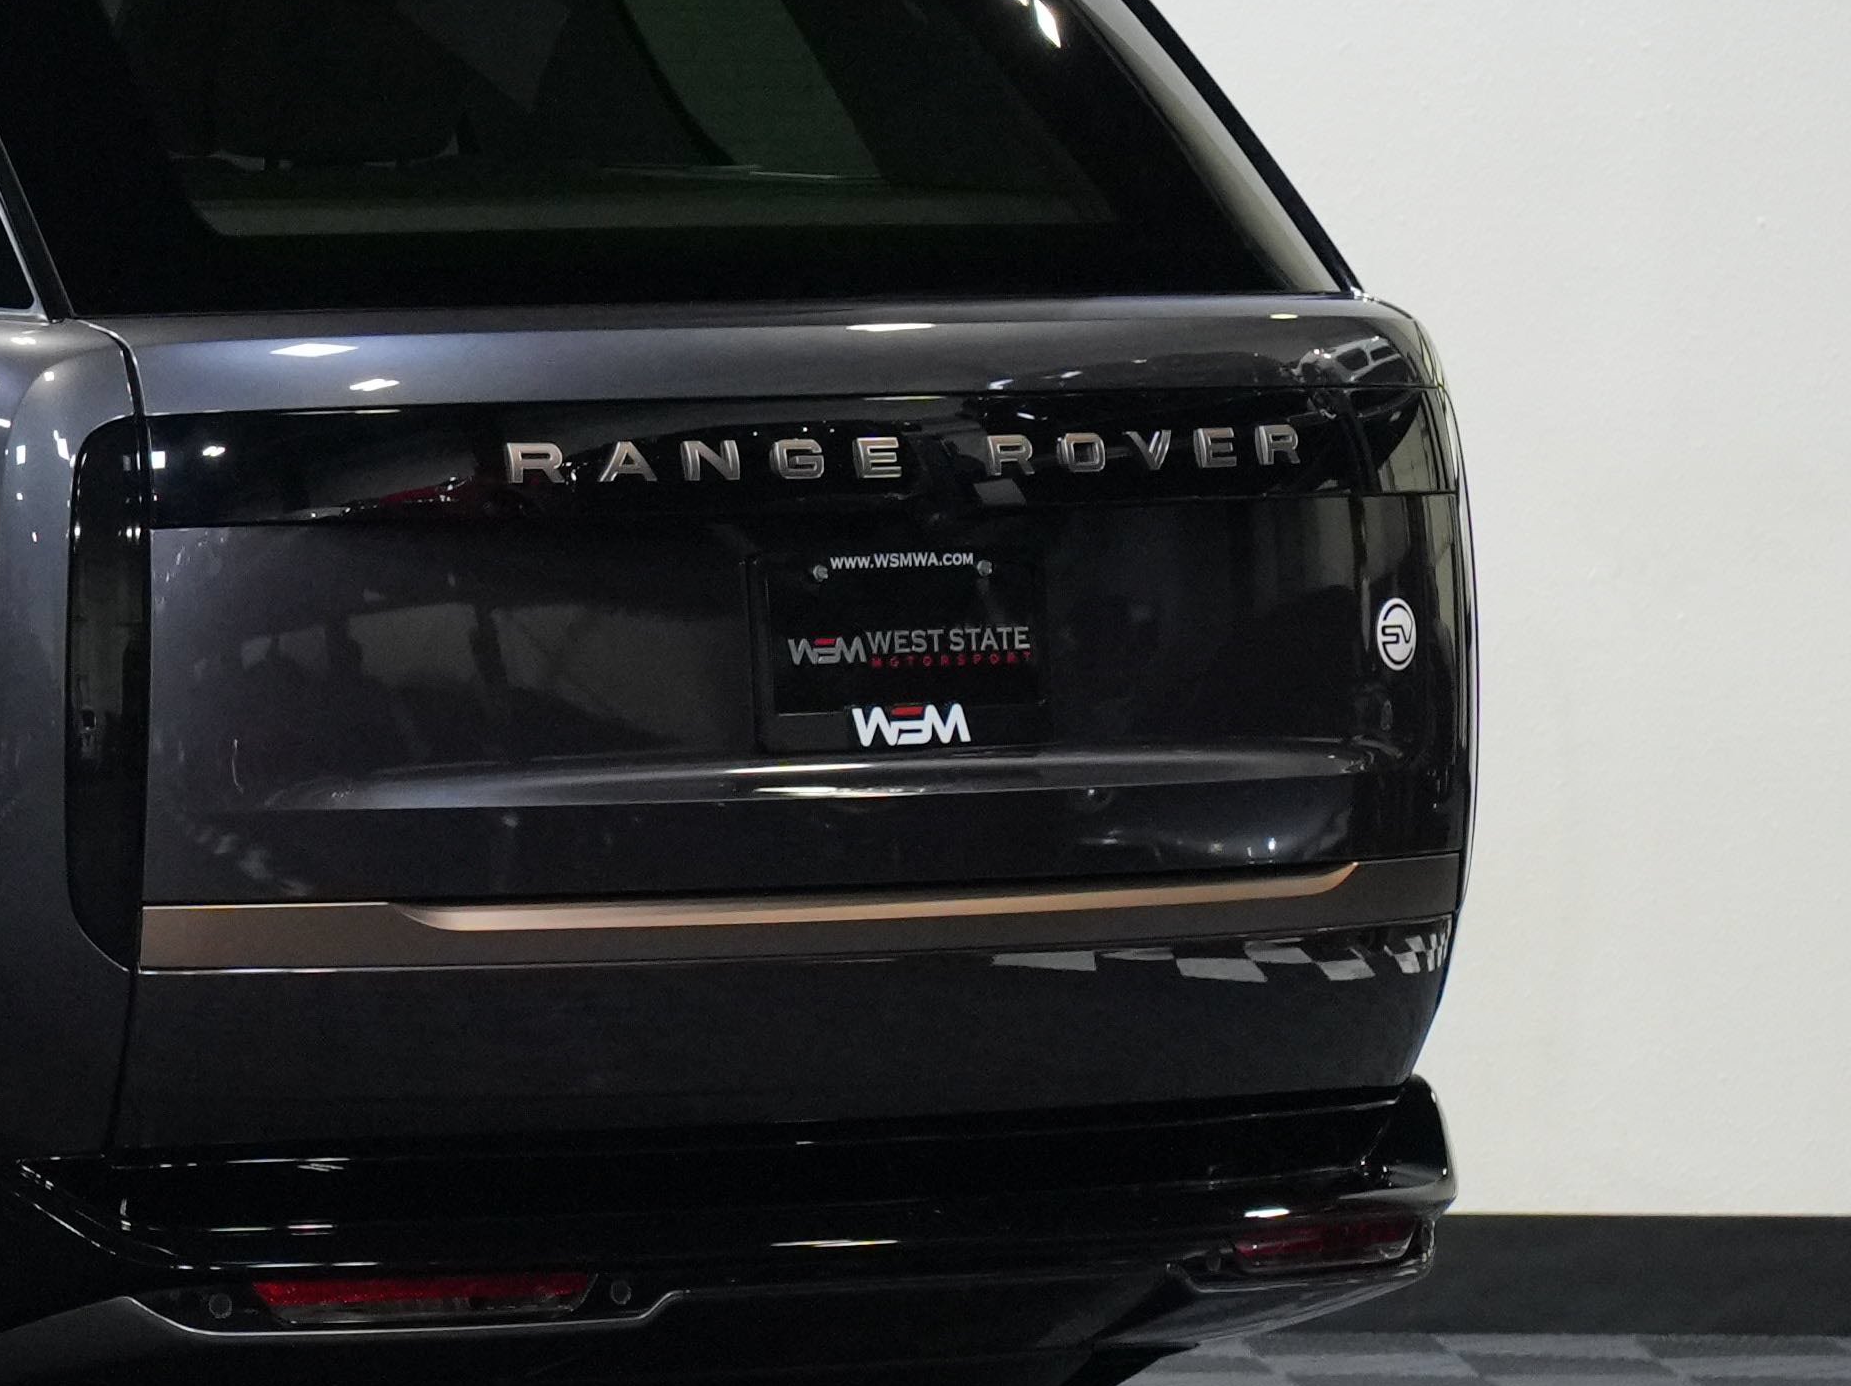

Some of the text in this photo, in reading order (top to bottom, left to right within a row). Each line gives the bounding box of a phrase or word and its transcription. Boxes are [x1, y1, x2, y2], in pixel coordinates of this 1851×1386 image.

[505, 423, 1301, 484] RANGE ROVER
[830, 551, 974, 570] WWW.WSMWA.COM
[866, 628, 944, 655] WEST
[949, 626, 1031, 652] STATE
